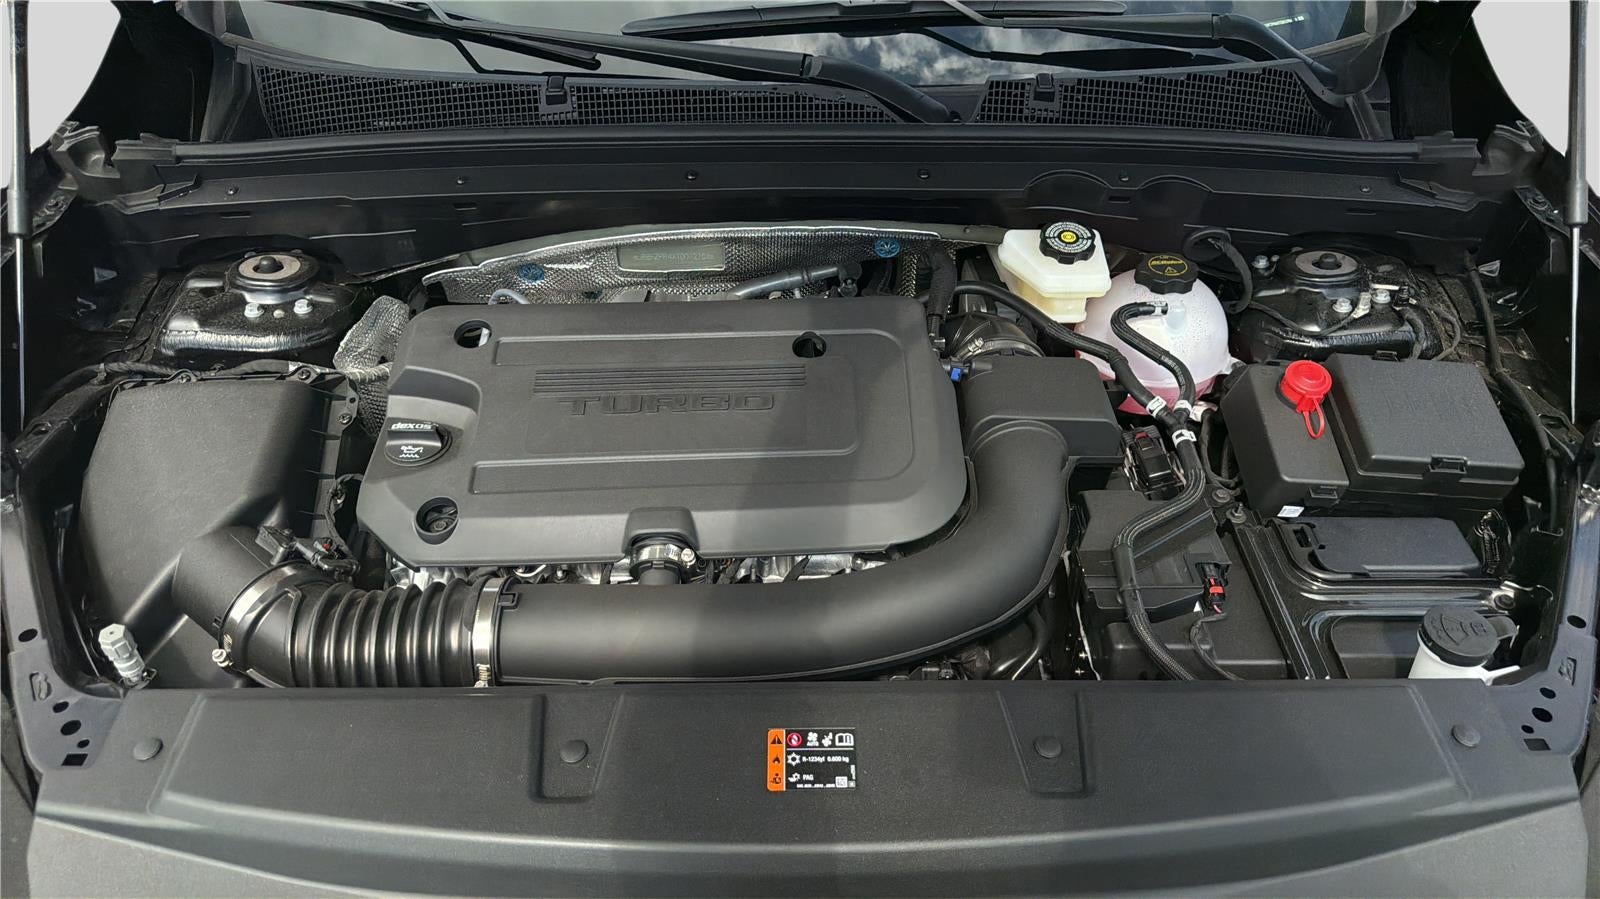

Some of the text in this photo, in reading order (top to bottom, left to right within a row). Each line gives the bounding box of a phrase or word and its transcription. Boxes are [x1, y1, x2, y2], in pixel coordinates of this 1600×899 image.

[558, 392, 776, 416] TURBO
[391, 421, 432, 430] dexos
[842, 756, 850, 764] kg
